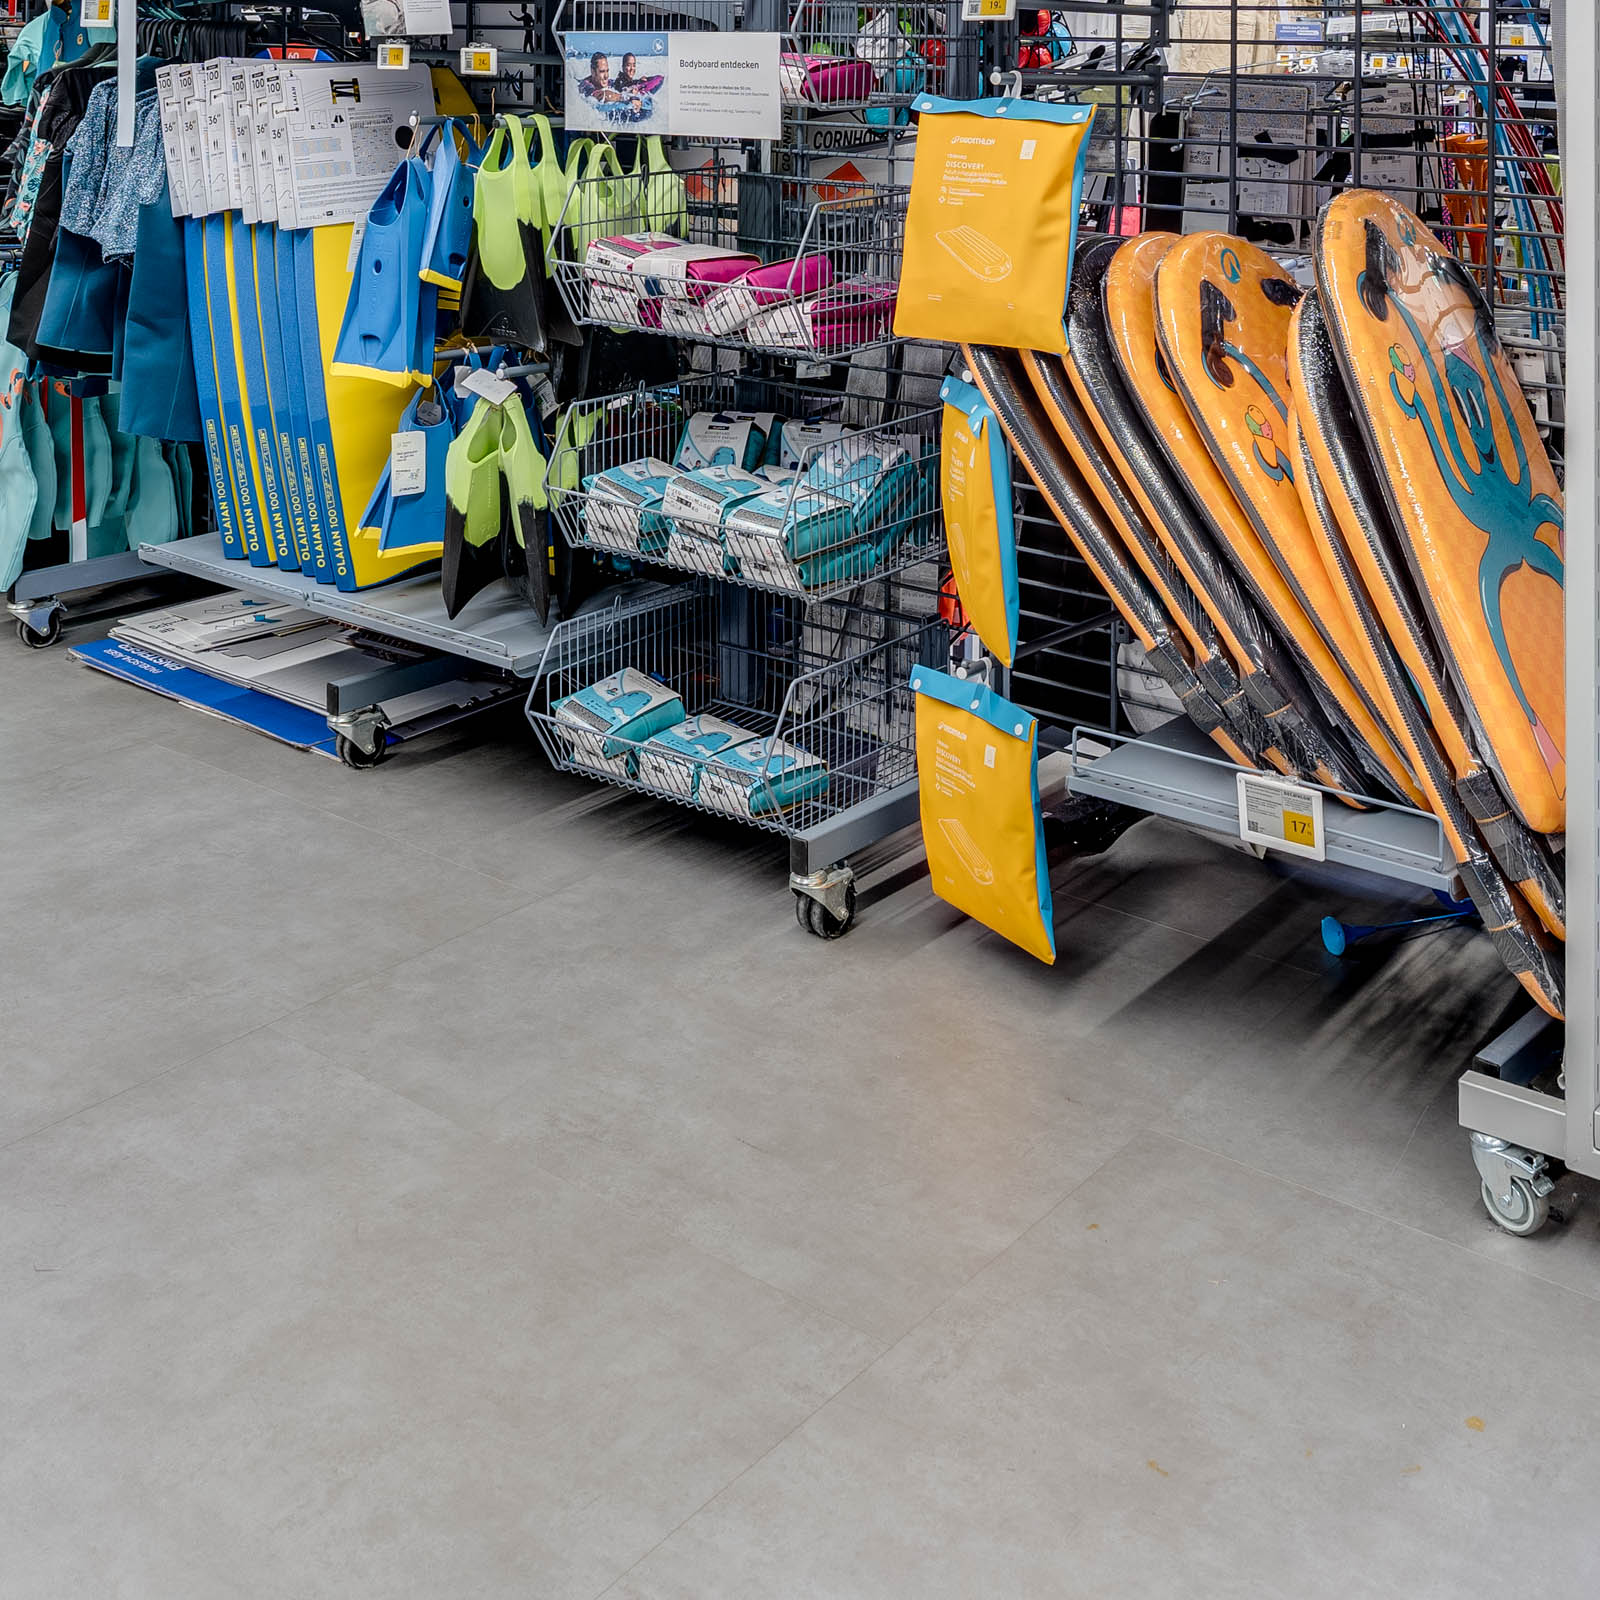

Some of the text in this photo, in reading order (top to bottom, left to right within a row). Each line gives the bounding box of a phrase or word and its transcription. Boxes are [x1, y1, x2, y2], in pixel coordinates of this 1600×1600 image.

[680, 59, 760, 70] Bodyboard entdecken
[206, 70, 219, 81] 100
[159, 78, 172, 89] 100
[179, 76, 192, 88] 100
[232, 81, 244, 92] 100
[252, 77, 265, 89] 100
[267, 82, 280, 93] 100
[216, 482, 234, 544] OLAIAN 100
[240, 487, 259, 551] OLAIAN 100
[269, 492, 288, 556] OLAIAN 100
[291, 496, 310, 561] OLAIAN 100
[307, 502, 326, 568] OLAIAN 100
[328, 509, 347, 576] OLAIAN 100
